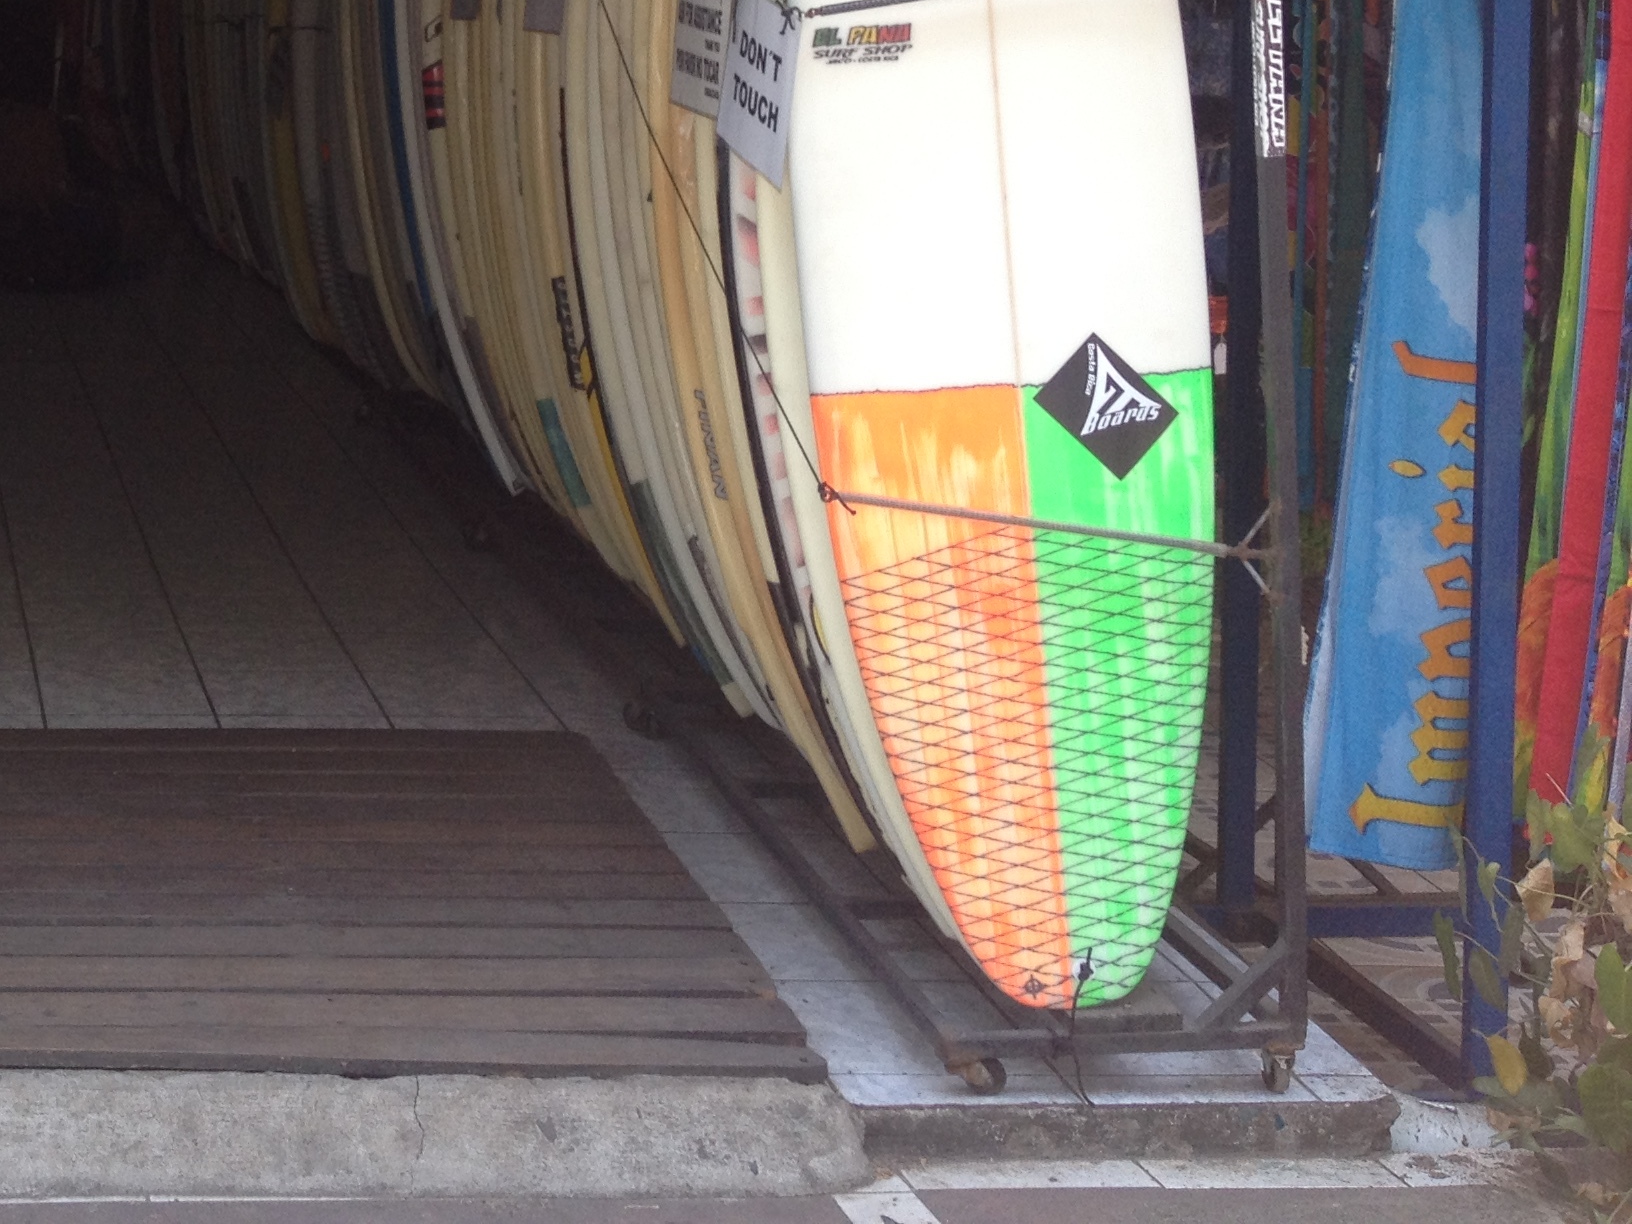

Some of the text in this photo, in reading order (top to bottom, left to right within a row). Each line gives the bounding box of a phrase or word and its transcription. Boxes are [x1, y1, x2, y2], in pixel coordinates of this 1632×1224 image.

[738, 29, 783, 83] DON'T
[813, 43, 913, 60] SURF SHOP
[846, 23, 912, 46] PANA
[732, 73, 779, 133] TOUCH
[1084, 342, 1097, 396] Costa Rica
[1081, 403, 1162, 436] Boards
